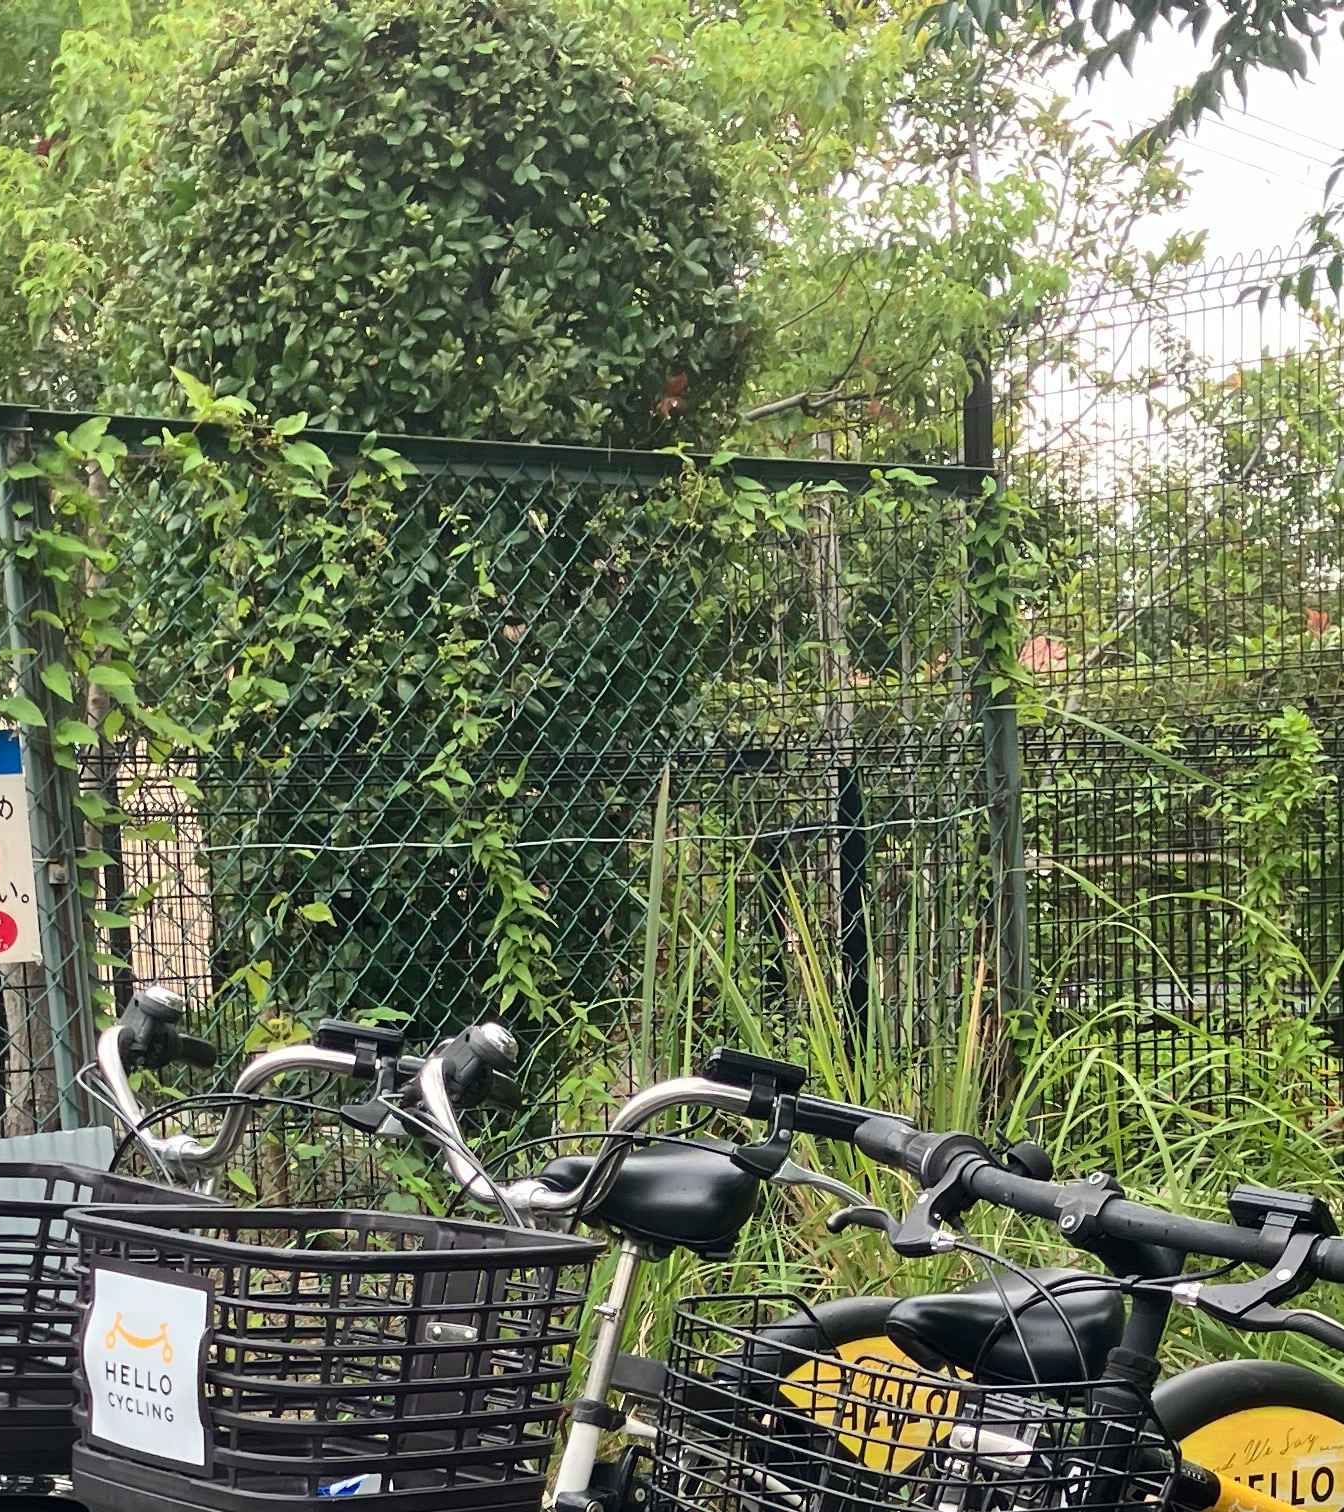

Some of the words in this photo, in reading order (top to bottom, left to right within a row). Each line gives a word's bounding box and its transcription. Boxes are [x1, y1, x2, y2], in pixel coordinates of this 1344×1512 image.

[105, 1360, 172, 1396] HELLO
[108, 1391, 174, 1423] CYCLING
[1234, 1466, 1334, 1506] ELLO
